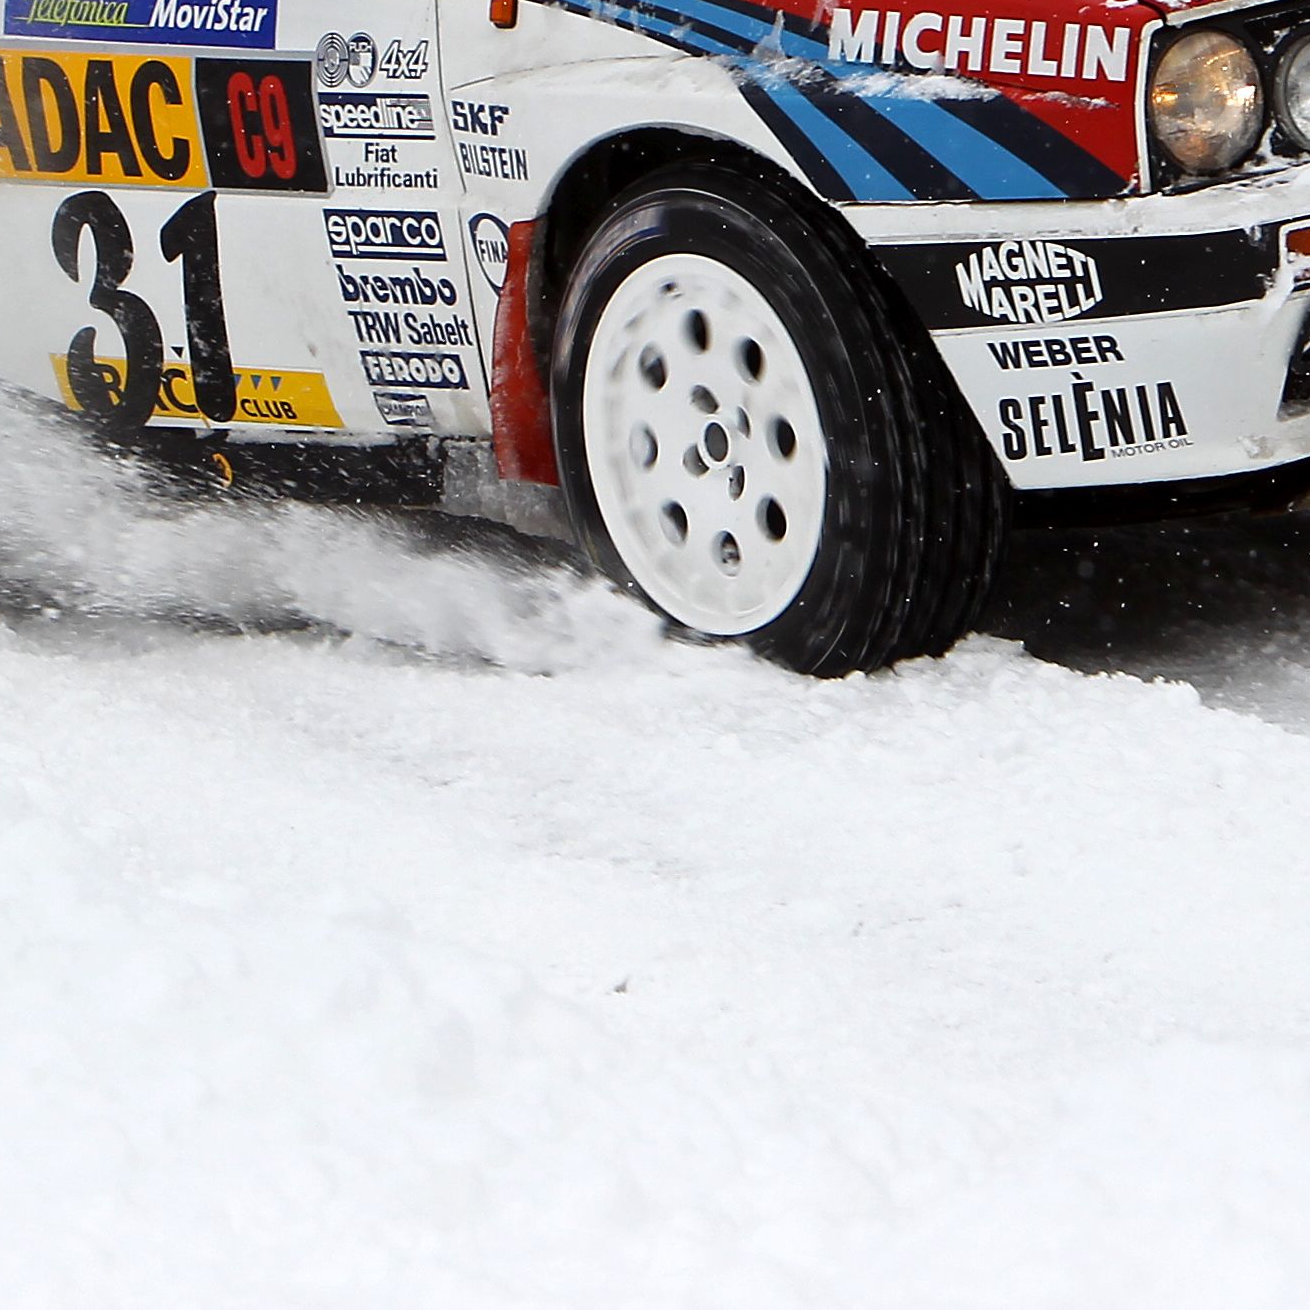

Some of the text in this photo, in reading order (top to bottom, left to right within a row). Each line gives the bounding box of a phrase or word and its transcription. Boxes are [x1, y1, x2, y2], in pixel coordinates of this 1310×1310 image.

[348, 41, 372, 53] PUCH
[379, 40, 429, 79] 4x4
[827, 8, 1131, 82] MICHELIN
[227, 72, 297, 179] C9
[451, 101, 510, 137] SKF
[364, 143, 398, 163] Fiat
[459, 143, 529, 181] BILSTEIN
[335, 167, 438, 189] Lubrificanti
[327, 215, 441, 256] sparco
[335, 264, 458, 306] brembo
[955, 240, 1103, 295] MAGNETI
[51, 190, 238, 428] 31
[955, 278, 1103, 324] MARELLI
[347, 310, 474, 347] TRW Sabelt
[365, 355, 461, 384] FERODO
[987, 335, 1125, 370] WEBER
[240, 398, 298, 420] CLUB
[997, 371, 1188, 462] SELÈNIA
[1111, 437, 1195, 459] MOTOR OIL
